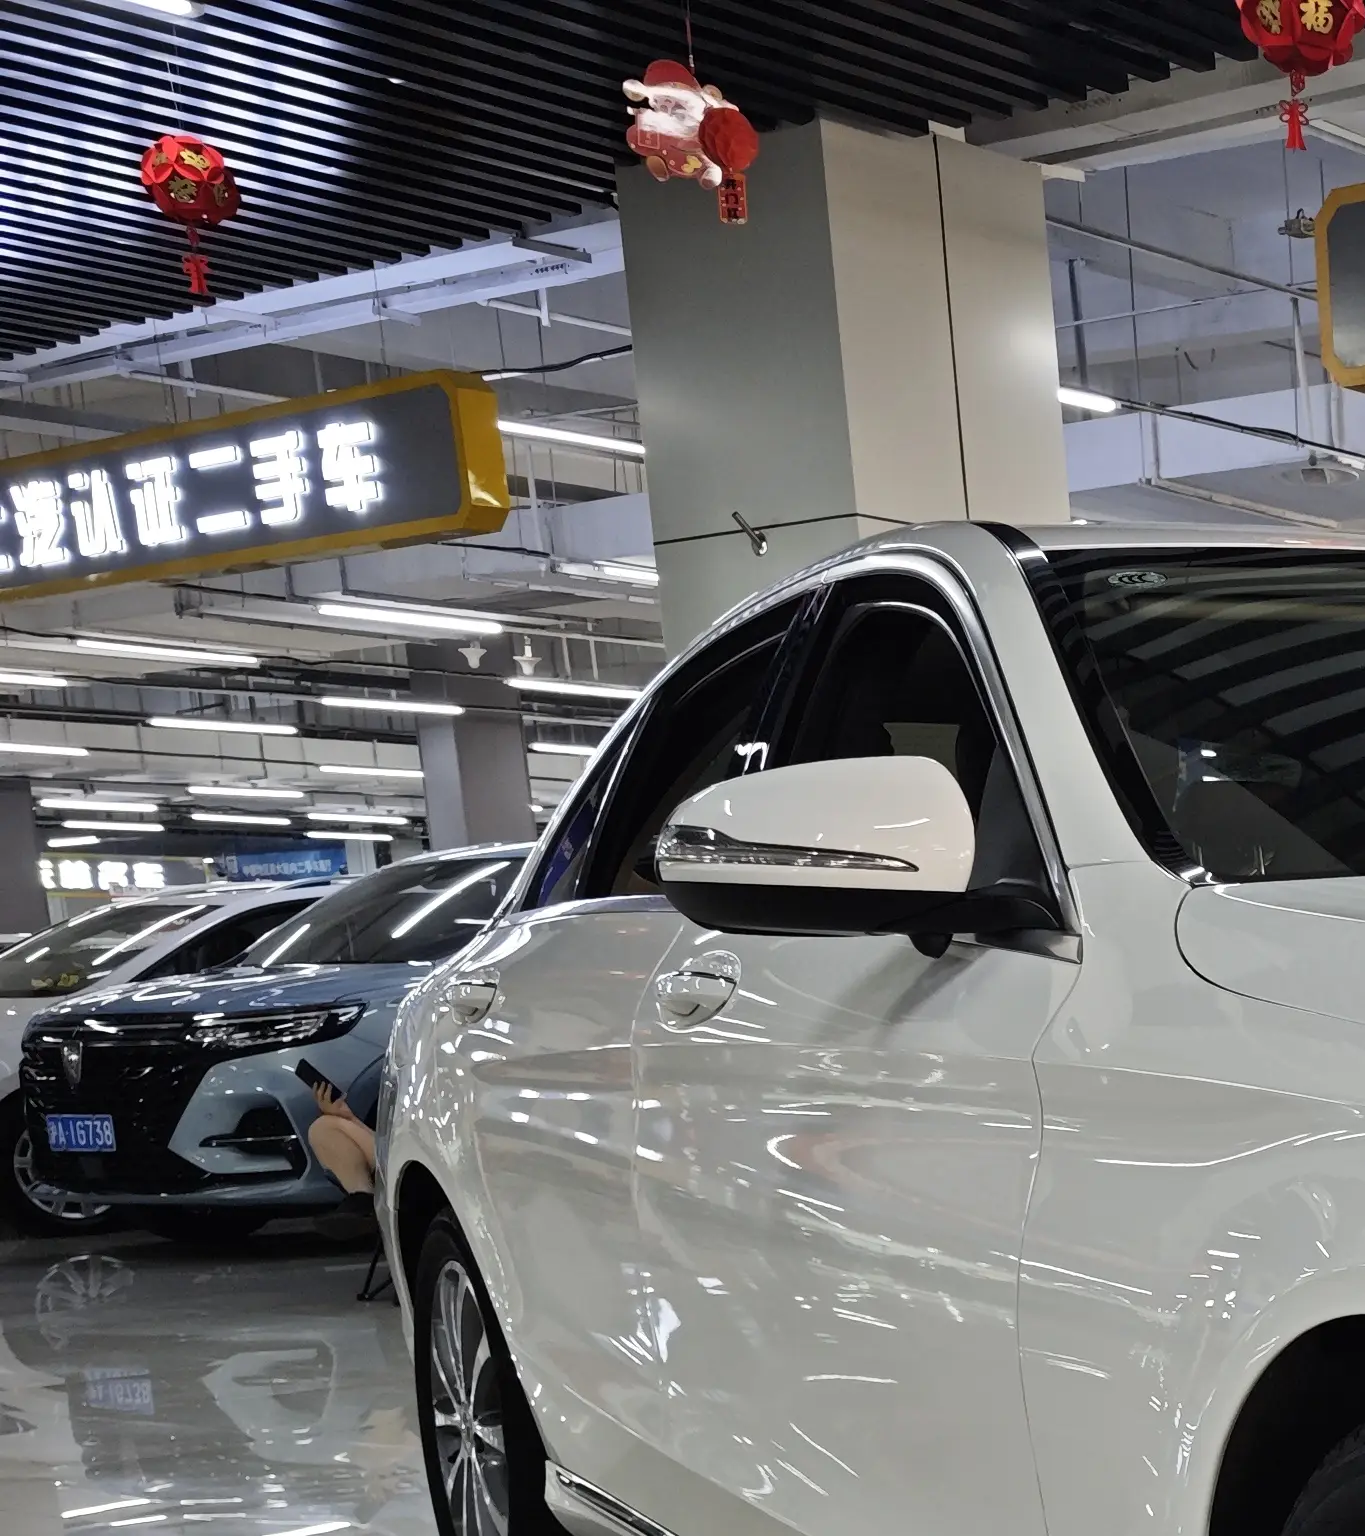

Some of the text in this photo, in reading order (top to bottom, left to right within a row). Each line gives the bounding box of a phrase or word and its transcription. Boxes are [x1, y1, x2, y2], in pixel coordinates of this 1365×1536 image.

[0, 421, 384, 571] 汽认证二手车
